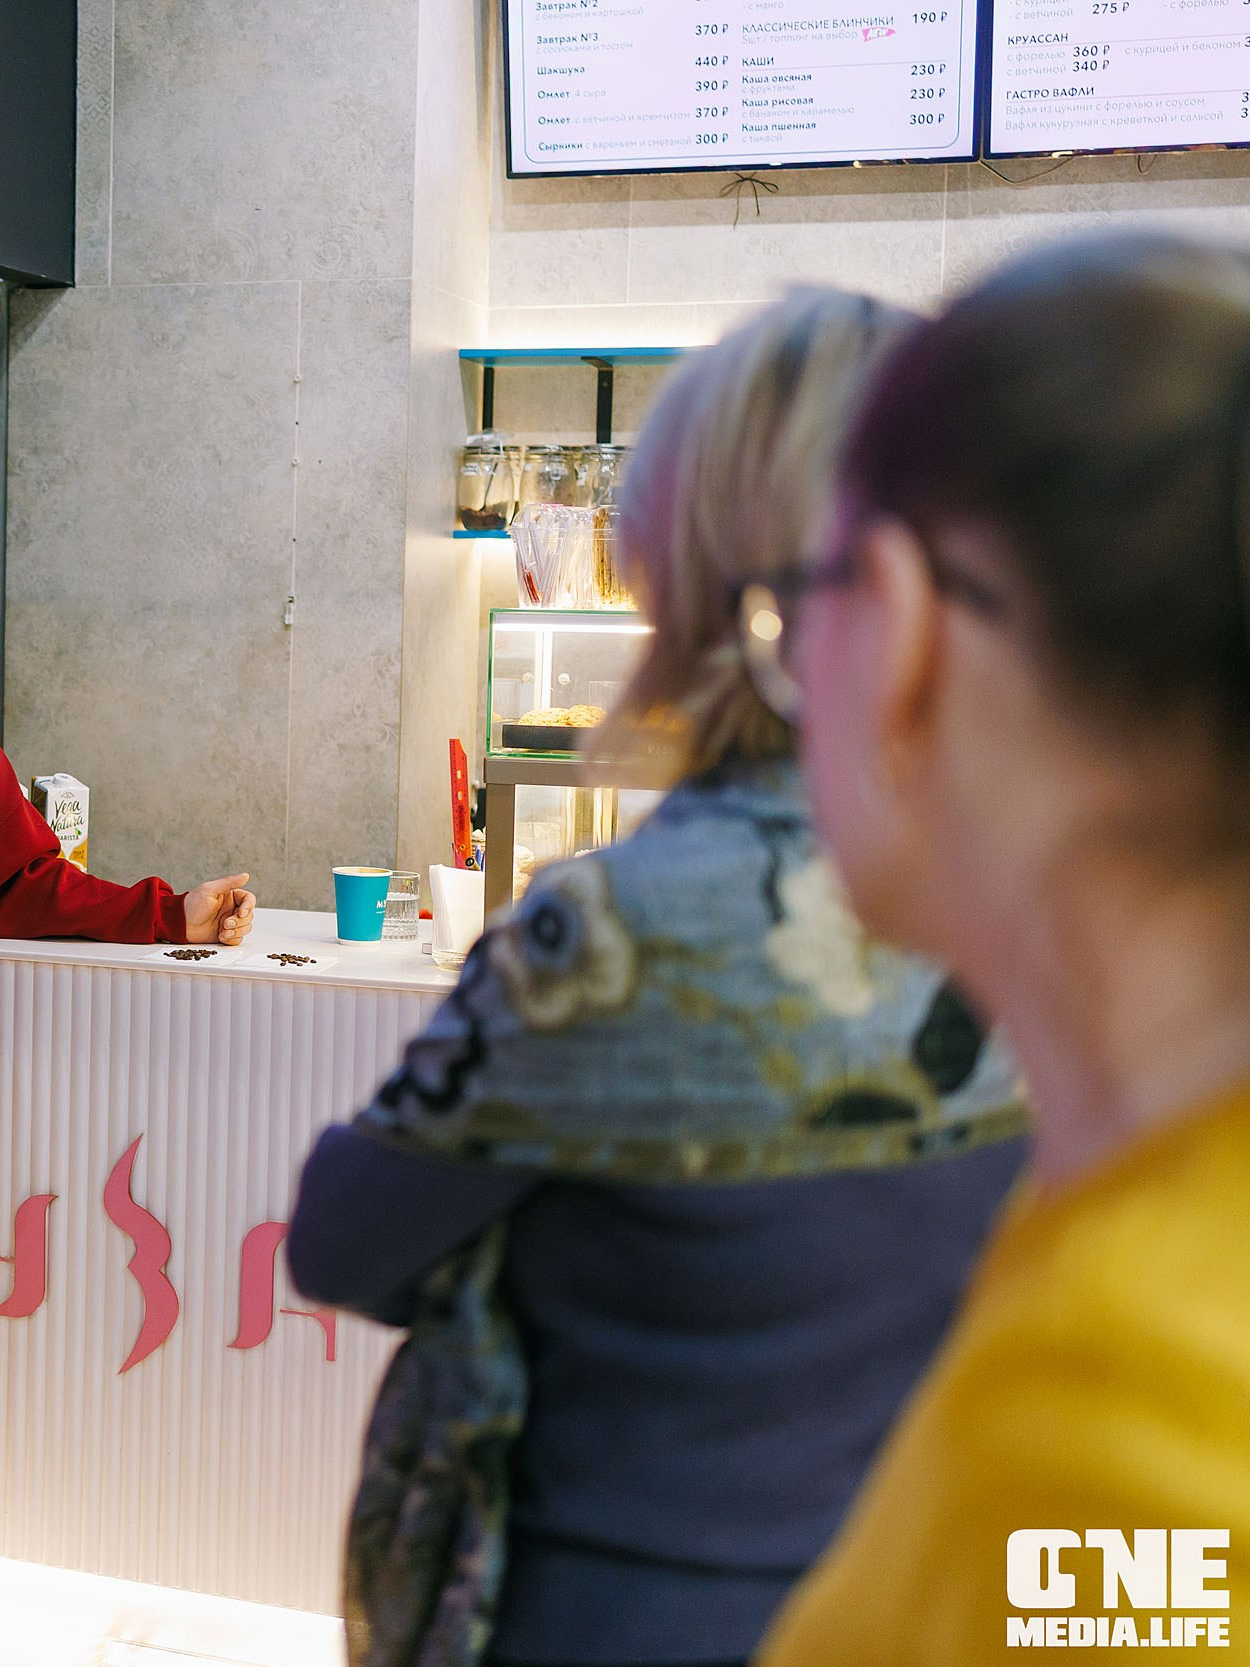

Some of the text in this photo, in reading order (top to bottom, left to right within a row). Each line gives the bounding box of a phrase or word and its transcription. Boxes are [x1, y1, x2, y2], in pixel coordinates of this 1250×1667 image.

[536, 2, 577, 12] Завтрак
[1092, 2, 1117, 14] 275
[912, 12, 936, 24] 190
[695, 24, 718, 36] 370
[742, 16, 894, 34] КЛАССИЧЕСКИЕ БЛИНЧИКИ
[536, 34, 578, 46] Завтрак
[1007, 33, 1069, 46] КРУАССАН
[1073, 45, 1099, 57] 360
[1133, 43, 1179, 56] курицей
[1192, 41, 1241, 52] беконом
[695, 56, 718, 67] 440
[742, 57, 775, 67] КАШИ
[1016, 51, 1066, 63] форелью
[537, 66, 586, 76] Шакшука
[911, 64, 935, 76] 230
[1015, 64, 1067, 76] ветчиной
[1072, 60, 1098, 72] 340
[742, 73, 812, 85] Каша овсяная
[695, 80, 718, 92] 390
[537, 90, 570, 99] Омлет
[910, 88, 934, 100] 230
[1006, 87, 1094, 100] ГАСТРО ВАФЛИ
[742, 97, 814, 108] Каша рисовая
[1006, 105, 1037, 116] Вафля
[1054, 104, 1092, 114] цукини
[1104, 100, 1153, 112] форелью
[1165, 98, 1205, 109] соусом
[695, 107, 718, 118] 370
[538, 116, 571, 125] Омлет
[910, 113, 934, 125] 300
[1005, 120, 1037, 131] Вафля
[1039, 118, 1099, 130] кукурузная
[1110, 114, 1168, 127] креветкой
[1180, 111, 1224, 122] сальсой
[742, 121, 817, 132] Каша пшенная
[695, 133, 718, 145] 300
[538, 142, 583, 153] Сырники
[54, 800, 83, 818] Vega
[50, 815, 85, 833] Natura
